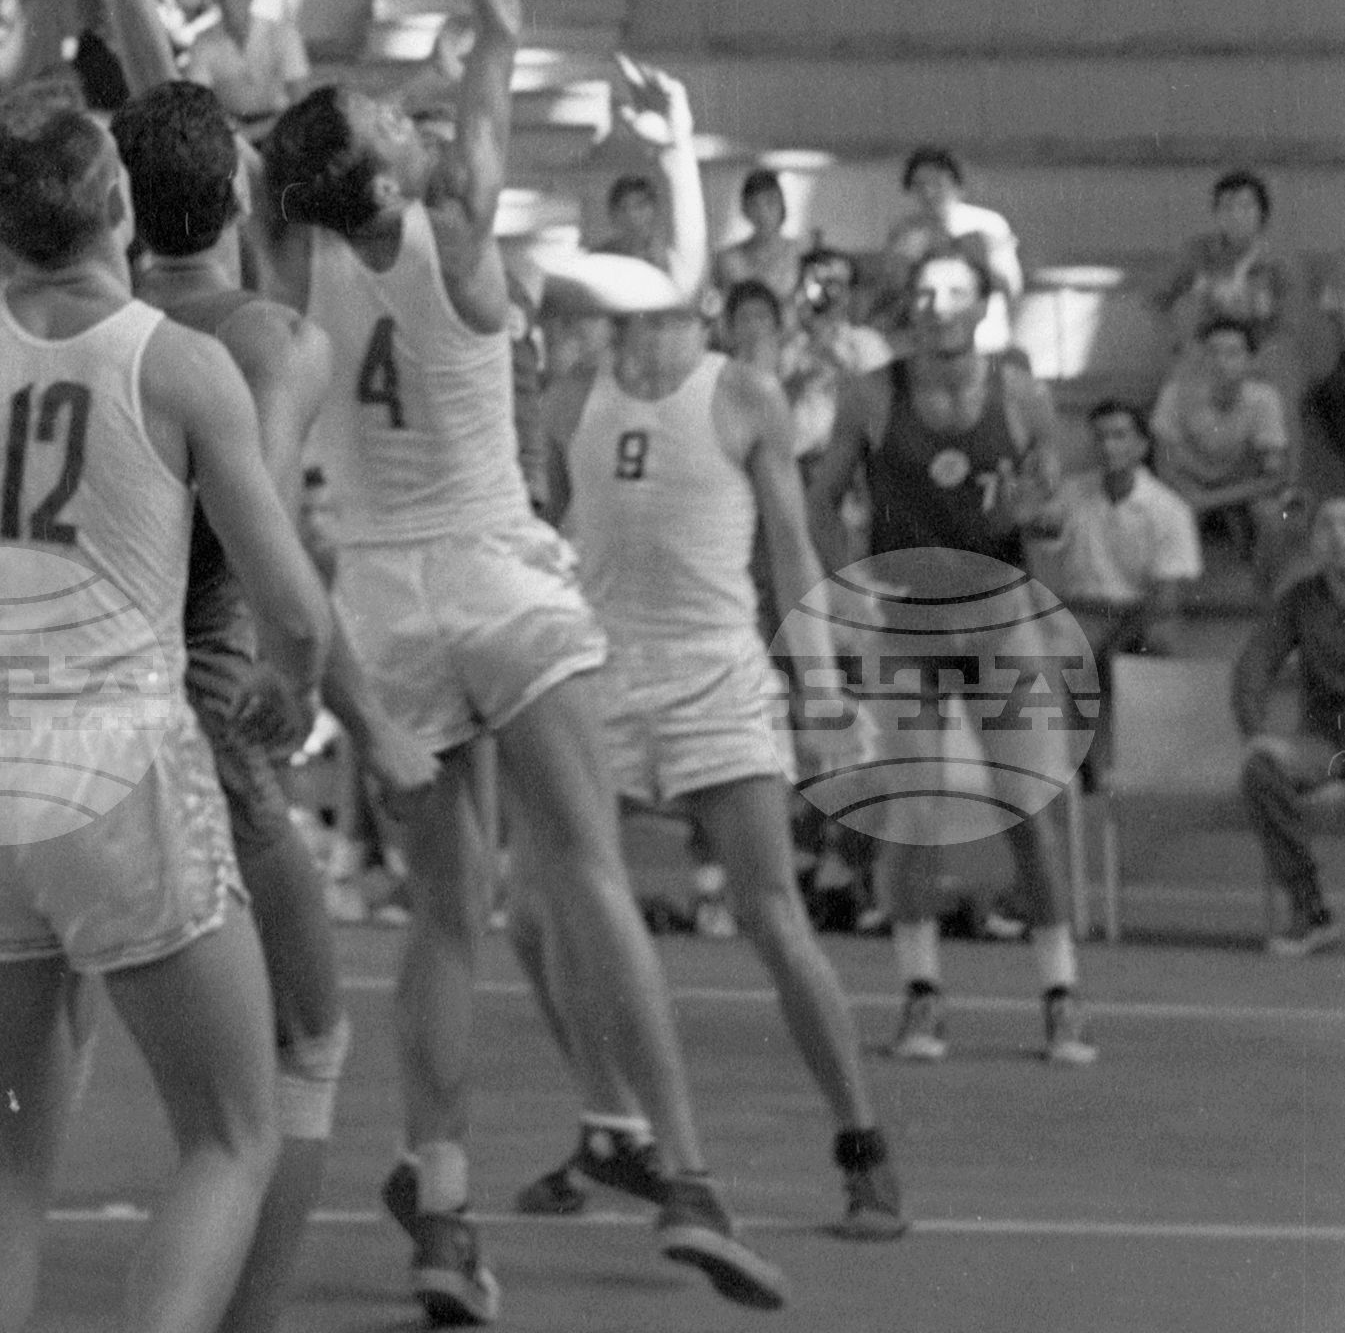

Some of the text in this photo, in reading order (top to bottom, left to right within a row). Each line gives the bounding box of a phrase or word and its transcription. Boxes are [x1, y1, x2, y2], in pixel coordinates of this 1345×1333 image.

[358, 315, 404, 429] 4
[0, 380, 92, 545] 12
[616, 428, 649, 481] 9
